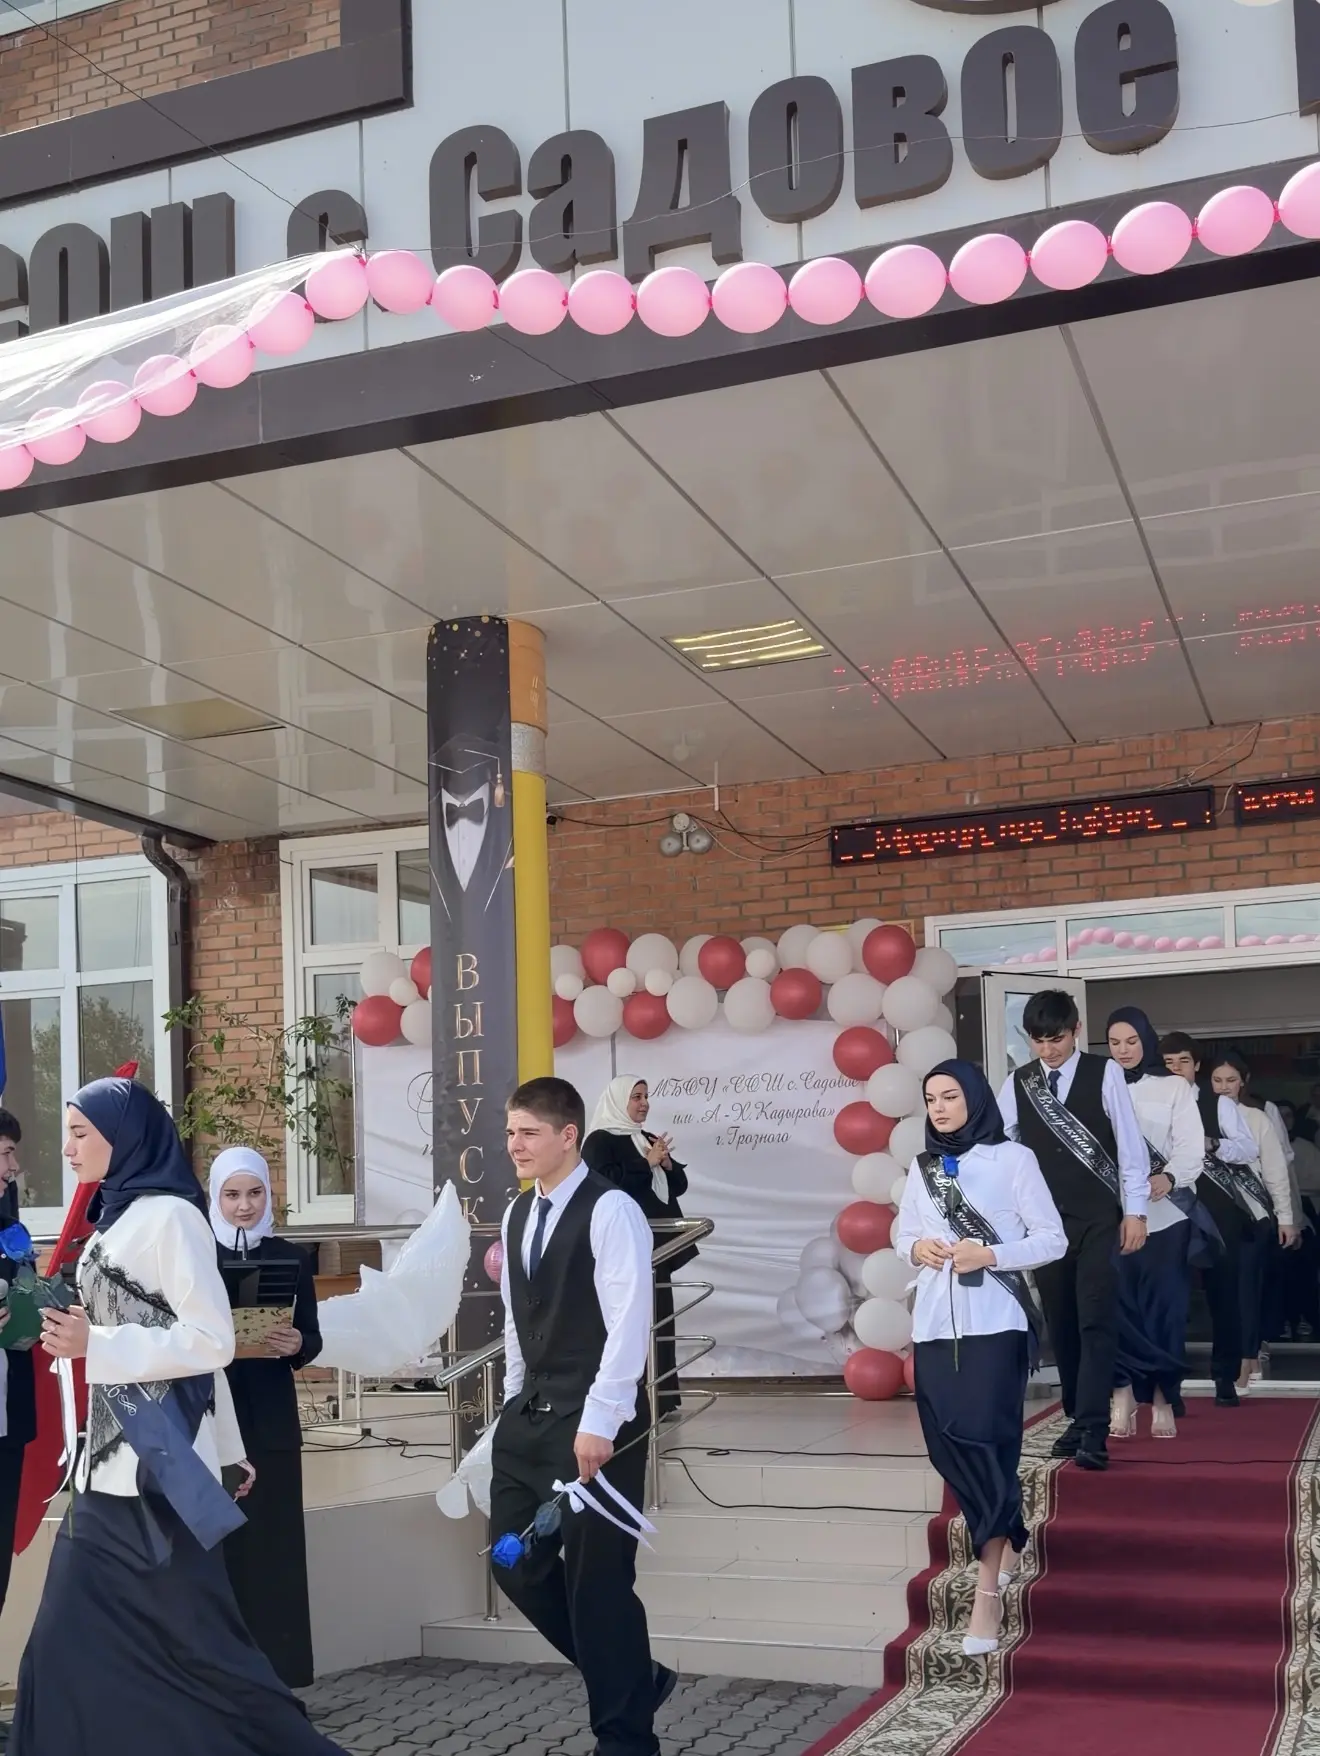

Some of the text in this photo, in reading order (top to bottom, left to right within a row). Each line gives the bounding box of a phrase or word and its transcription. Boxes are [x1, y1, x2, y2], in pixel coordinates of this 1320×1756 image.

[429, 0, 1181, 287] Садовое
[454, 953, 485, 1225] ВЫПУСК
[649, 1077, 718, 1101] МБОУ
[800, 1071, 860, 1096] Садовое
[727, 1126, 792, 1151] Грозного
[1036, 1087, 1095, 1156] Выпускник
